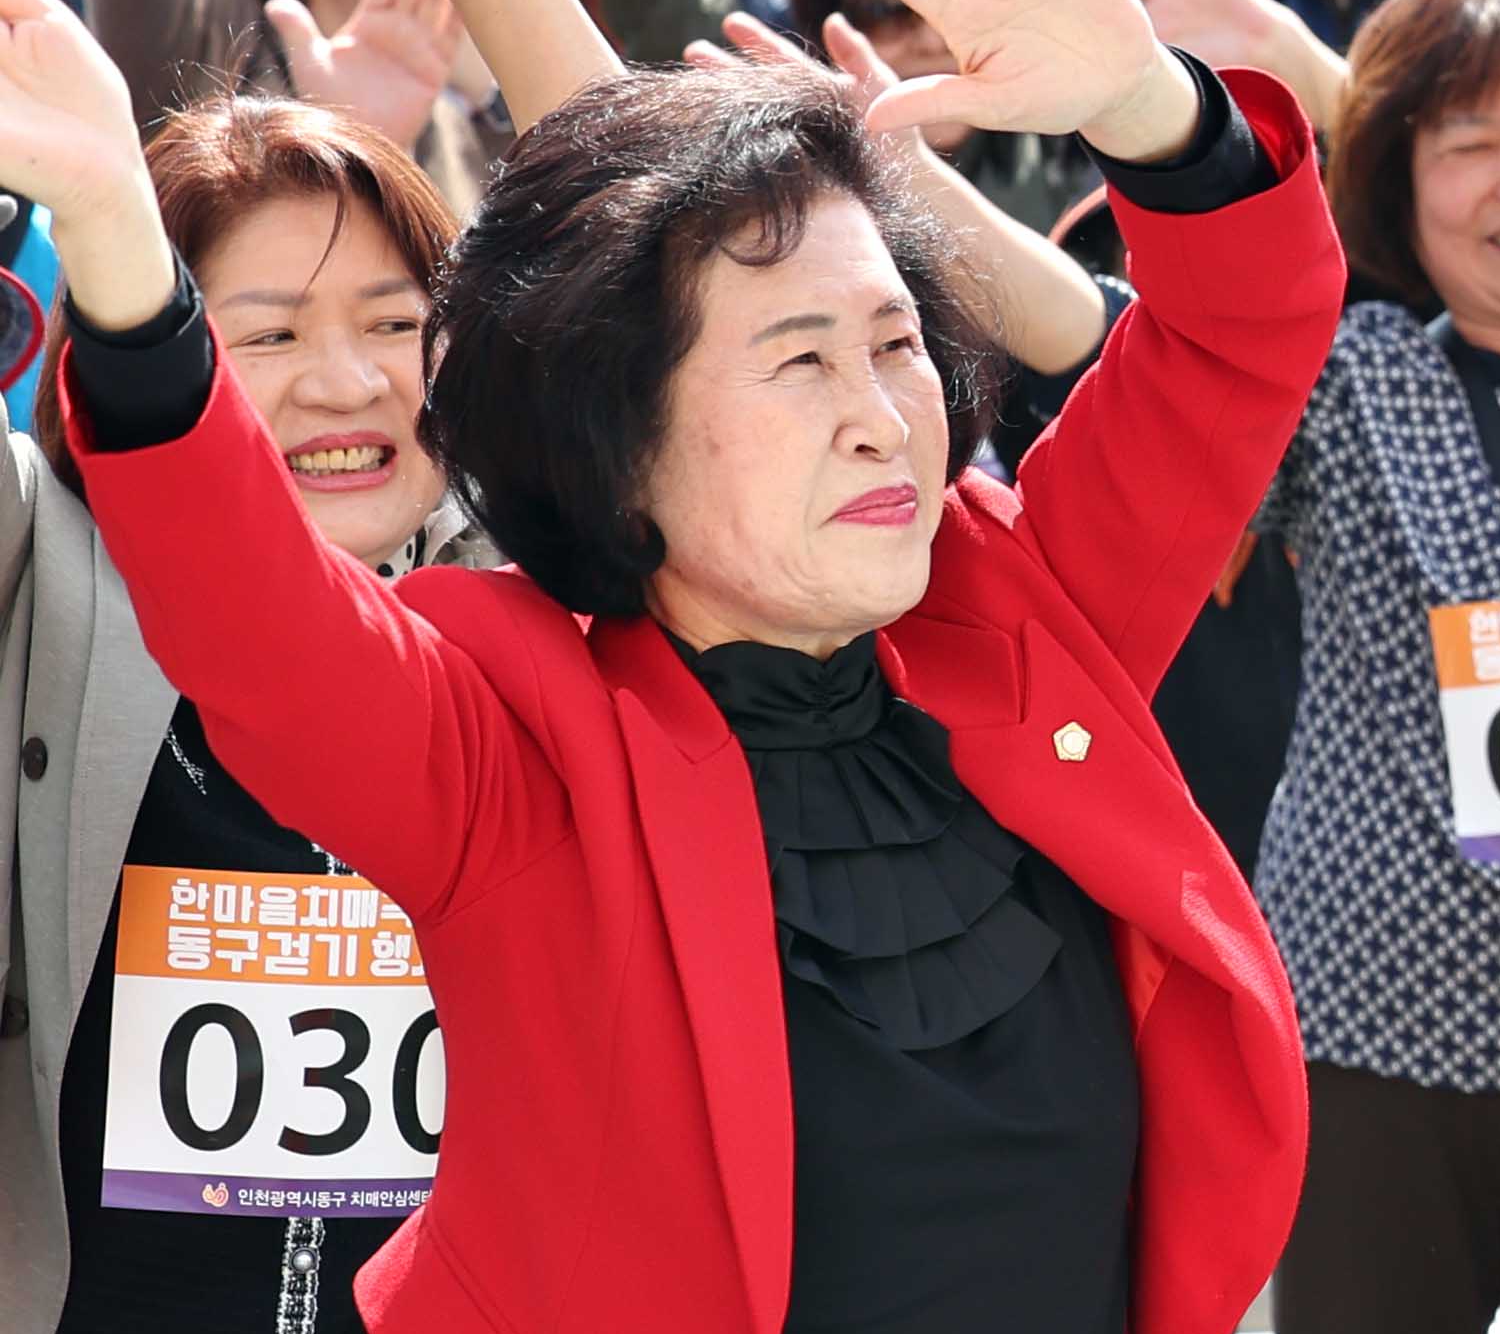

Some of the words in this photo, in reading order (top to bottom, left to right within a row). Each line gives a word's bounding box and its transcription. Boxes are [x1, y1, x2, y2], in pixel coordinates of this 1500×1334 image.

[168, 878, 413, 928] 한마음치매
[167, 925, 358, 978] 동구걷기
[369, 930, 425, 977] 행
[237, 1188, 347, 1208] 인천광역시동구
